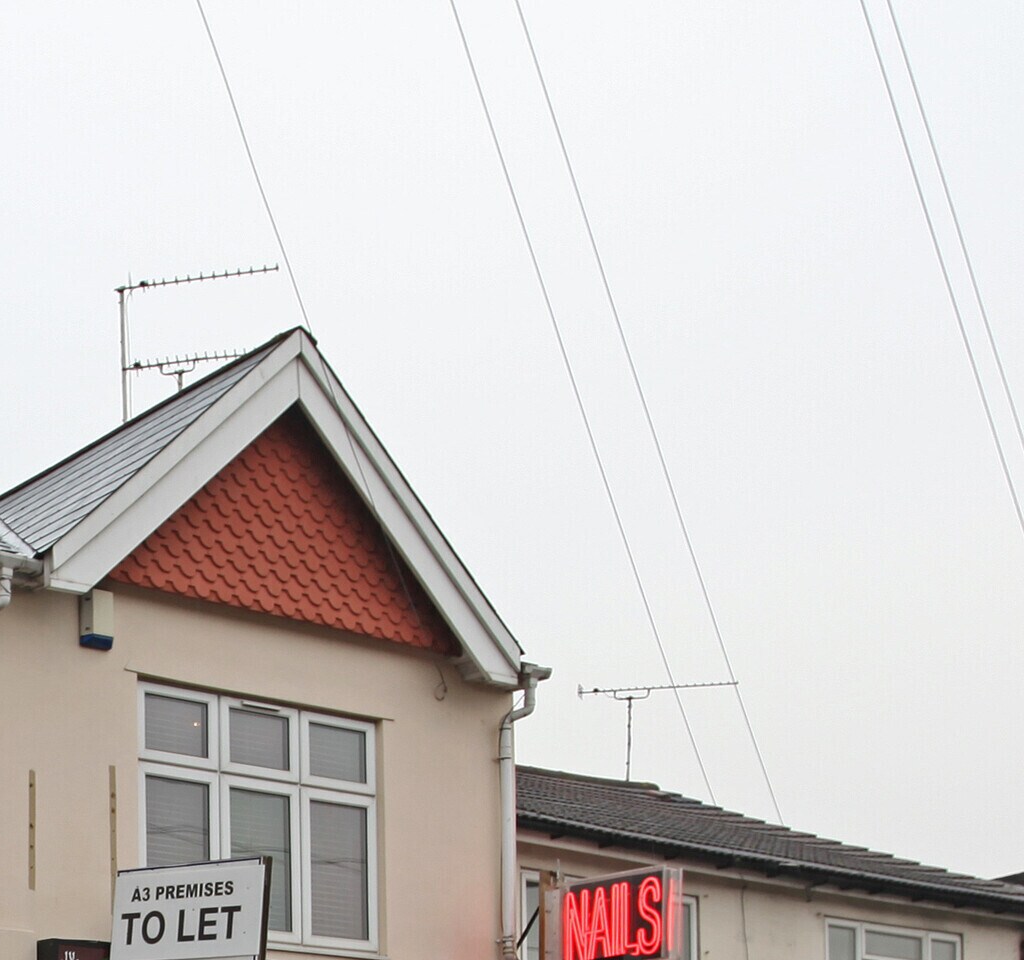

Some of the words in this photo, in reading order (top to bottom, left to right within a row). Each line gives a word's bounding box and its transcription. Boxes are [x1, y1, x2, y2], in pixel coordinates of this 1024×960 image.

[131, 887, 150, 902] A3
[155, 880, 234, 900] PREMISES
[121, 910, 166, 945] TO
[177, 905, 242, 942] LET
